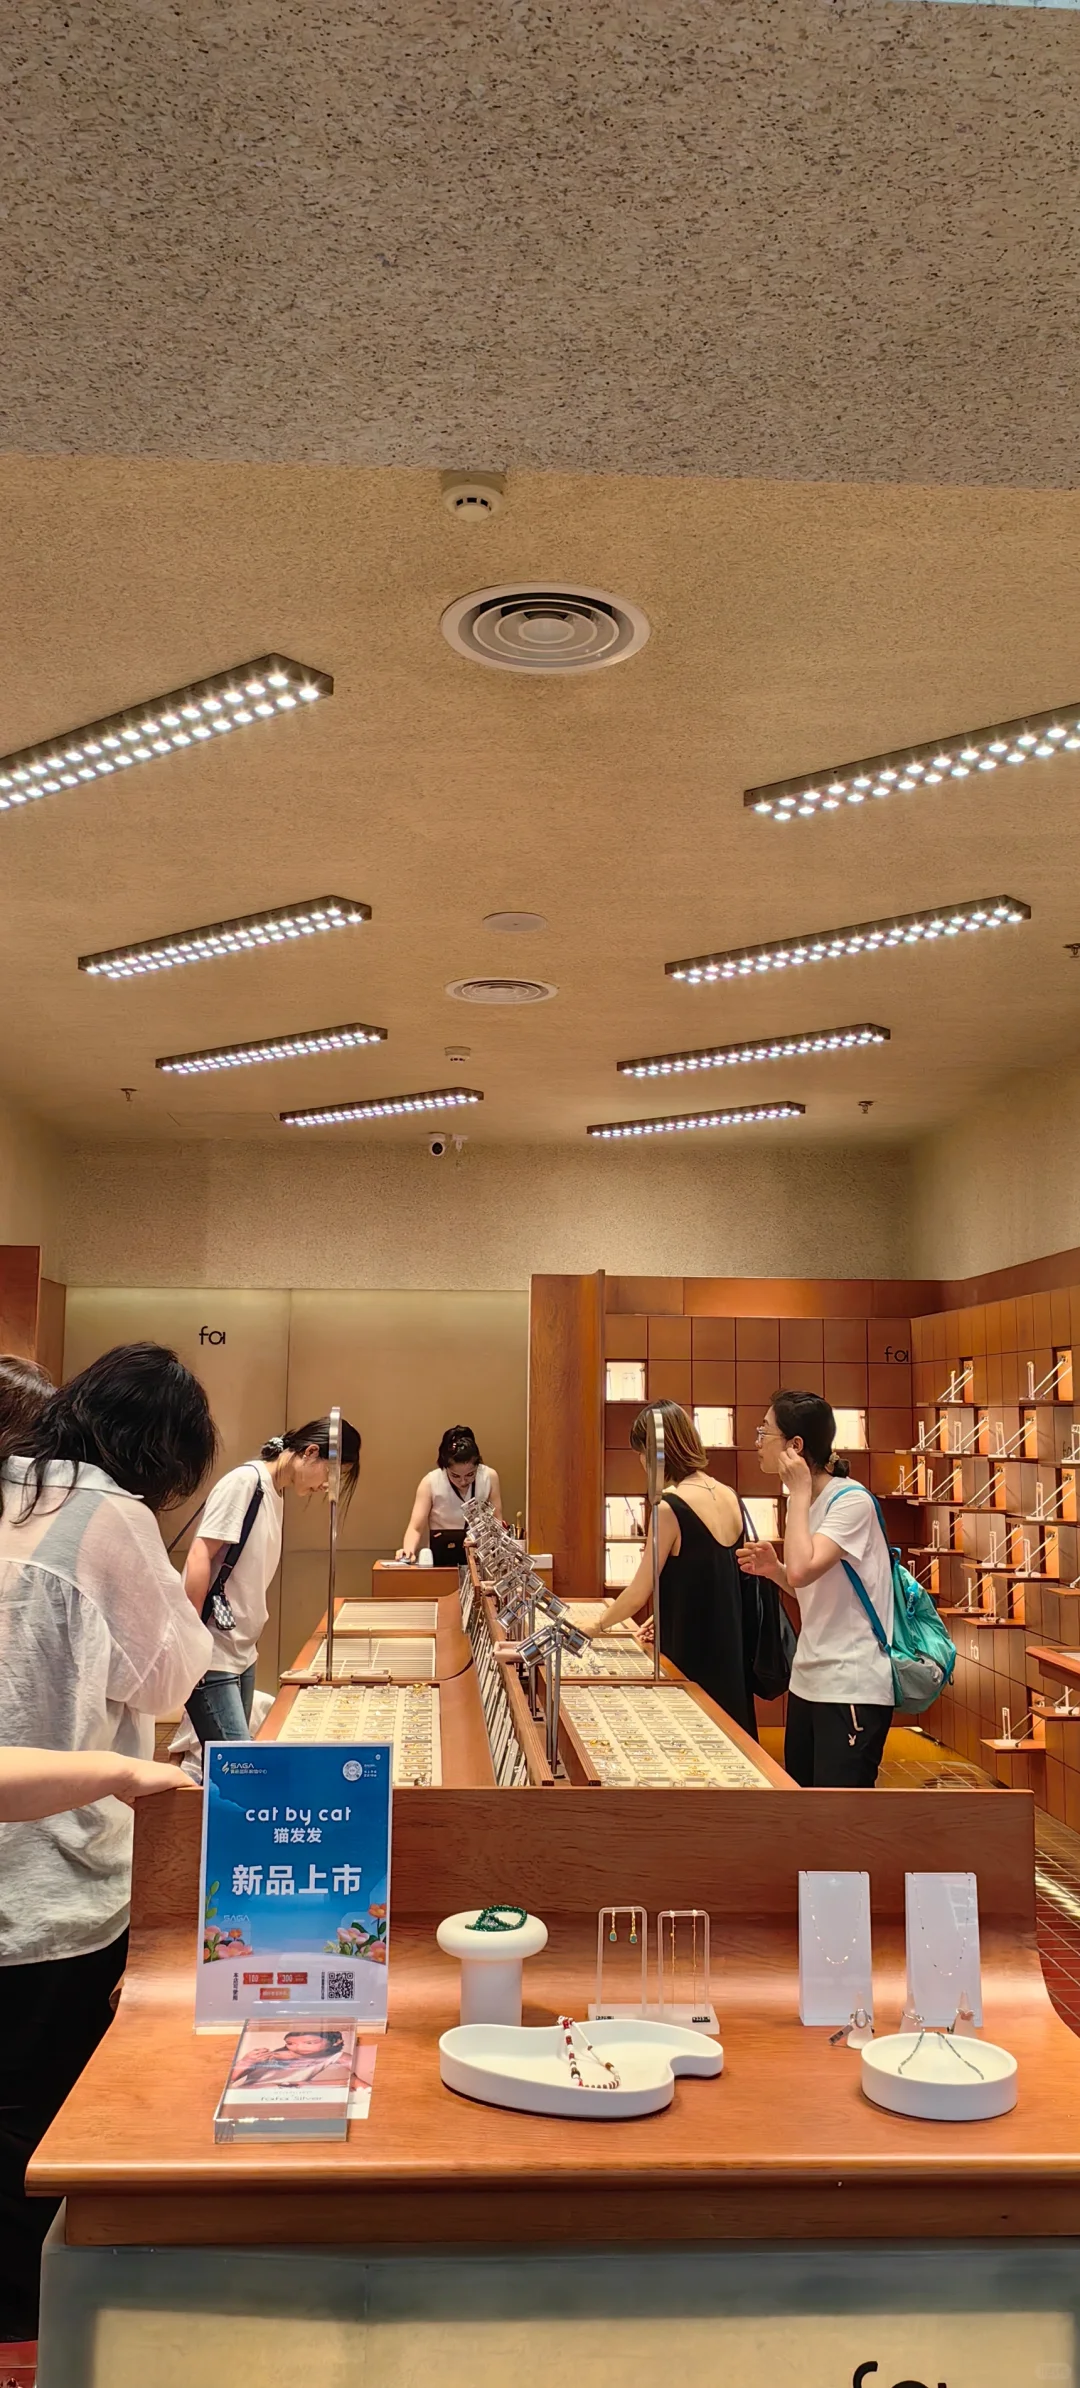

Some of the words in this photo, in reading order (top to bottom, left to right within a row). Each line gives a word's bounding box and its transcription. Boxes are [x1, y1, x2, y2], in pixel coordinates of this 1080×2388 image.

[245, 1806, 278, 1822] cat
[285, 1806, 311, 1826] by
[318, 1806, 352, 1822] cat
[273, 1827, 322, 1844] 猫发发
[231, 1863, 362, 1896] 新品上市
[223, 1914, 250, 1922] SAGA
[281, 1974, 293, 1982] 300
